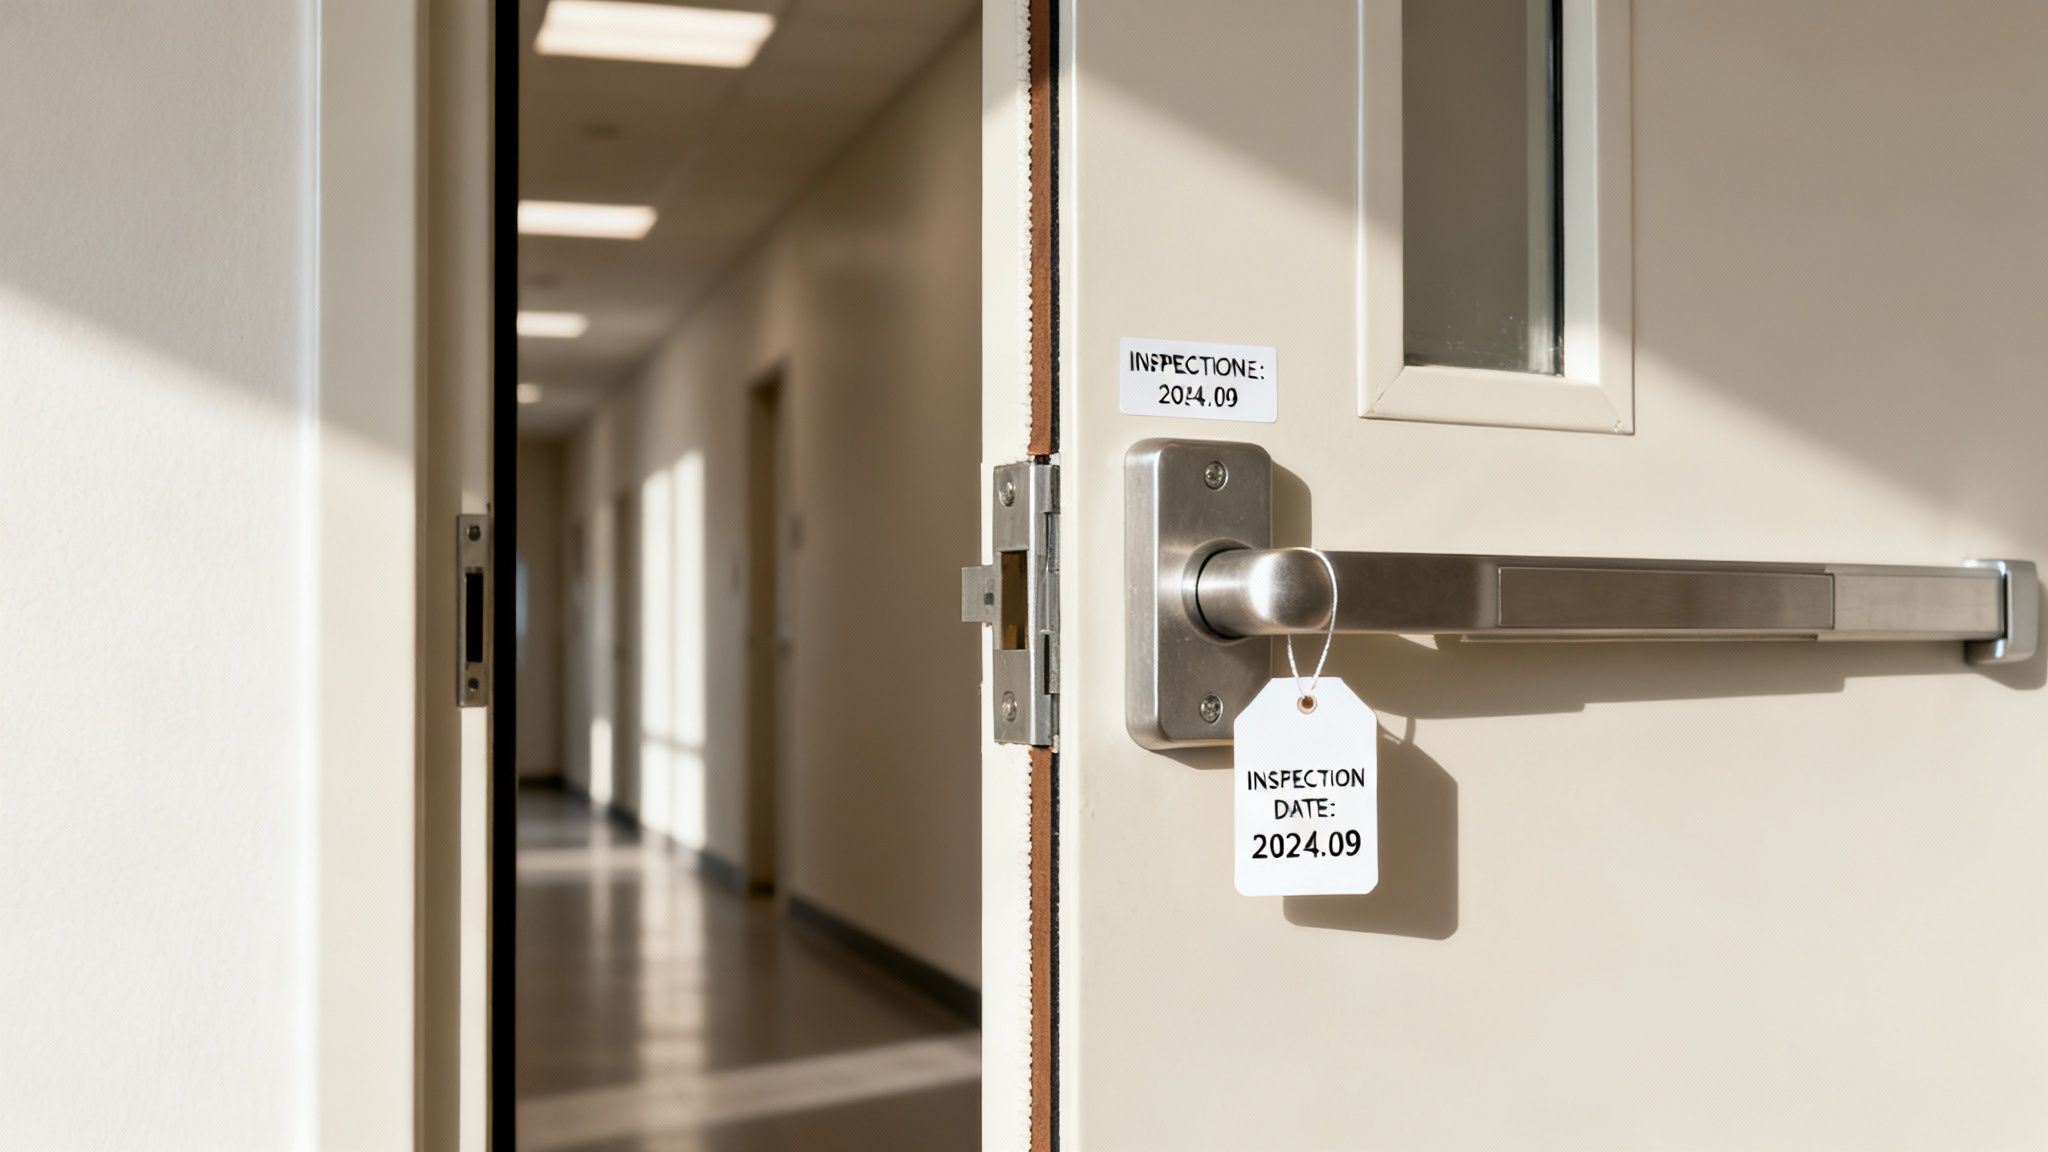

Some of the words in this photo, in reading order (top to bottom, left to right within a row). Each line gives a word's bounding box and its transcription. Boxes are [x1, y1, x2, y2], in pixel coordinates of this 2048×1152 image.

[1247, 768, 1366, 791] INSPECTION
[1274, 797, 1336, 820] DATE:
[1251, 829, 1362, 859] 2024.09
